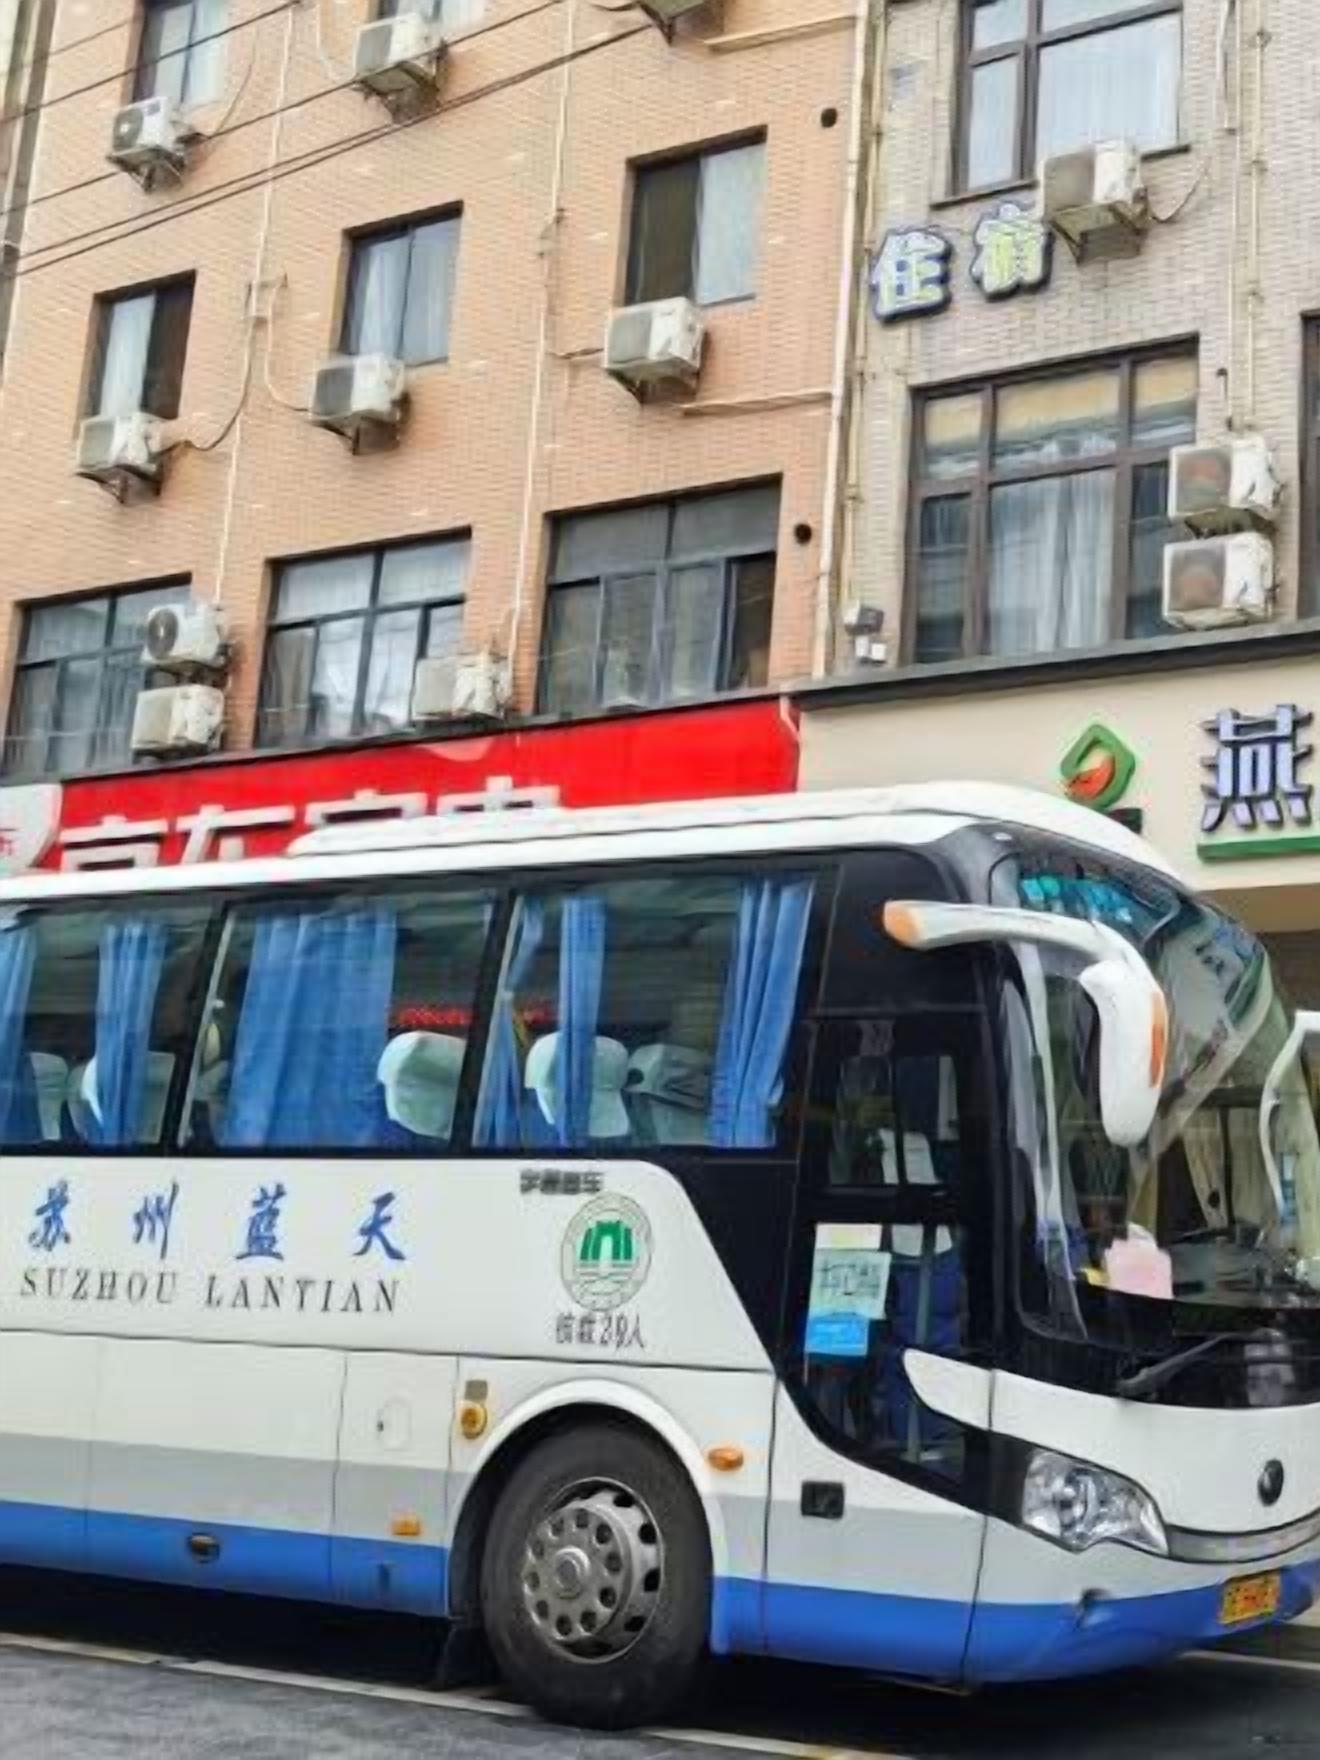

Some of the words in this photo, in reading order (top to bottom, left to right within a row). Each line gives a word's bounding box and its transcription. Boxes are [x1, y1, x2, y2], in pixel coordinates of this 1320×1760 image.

[28, 1180, 406, 1262] 苏州蓝天
[20, 1267, 178, 1305] SUZHOU
[203, 1273, 402, 1314] LANTIAN
